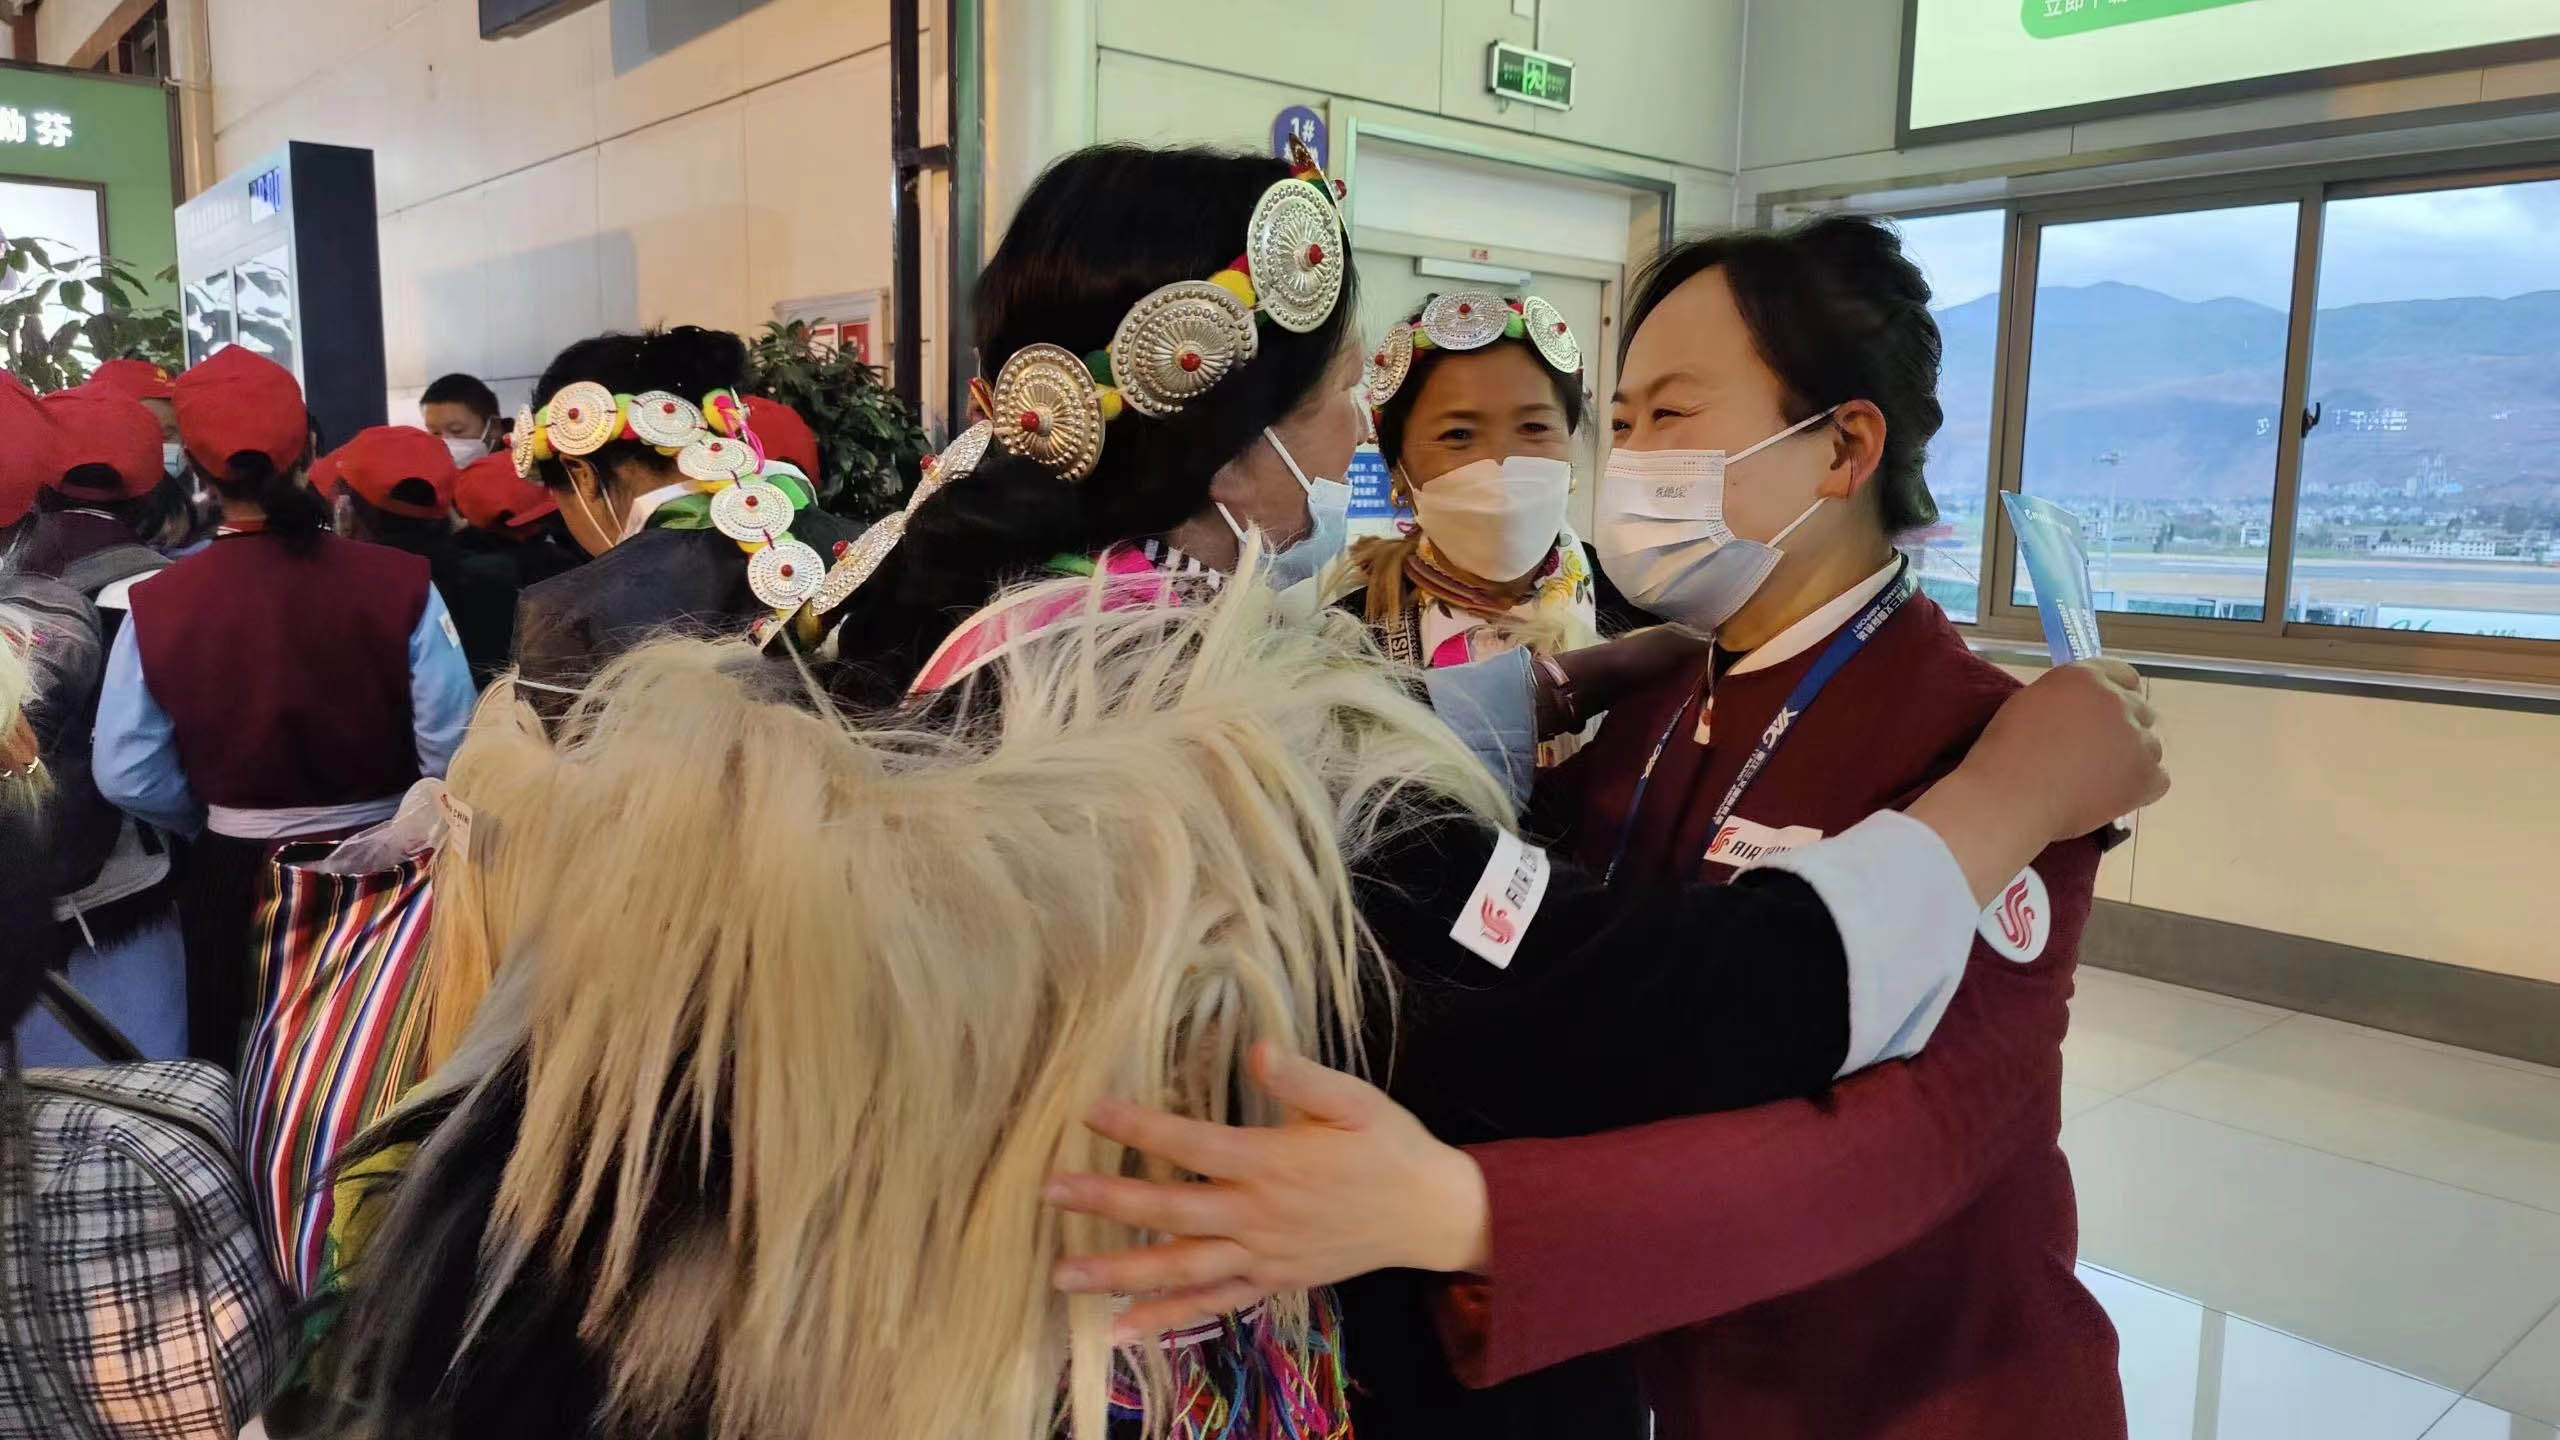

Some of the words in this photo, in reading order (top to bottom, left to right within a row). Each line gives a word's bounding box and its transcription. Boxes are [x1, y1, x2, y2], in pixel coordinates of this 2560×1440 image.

[2043, 0, 2128, 17] 立即
[1729, 841, 1762, 861] AIR
[1505, 866, 1533, 910] AIR
